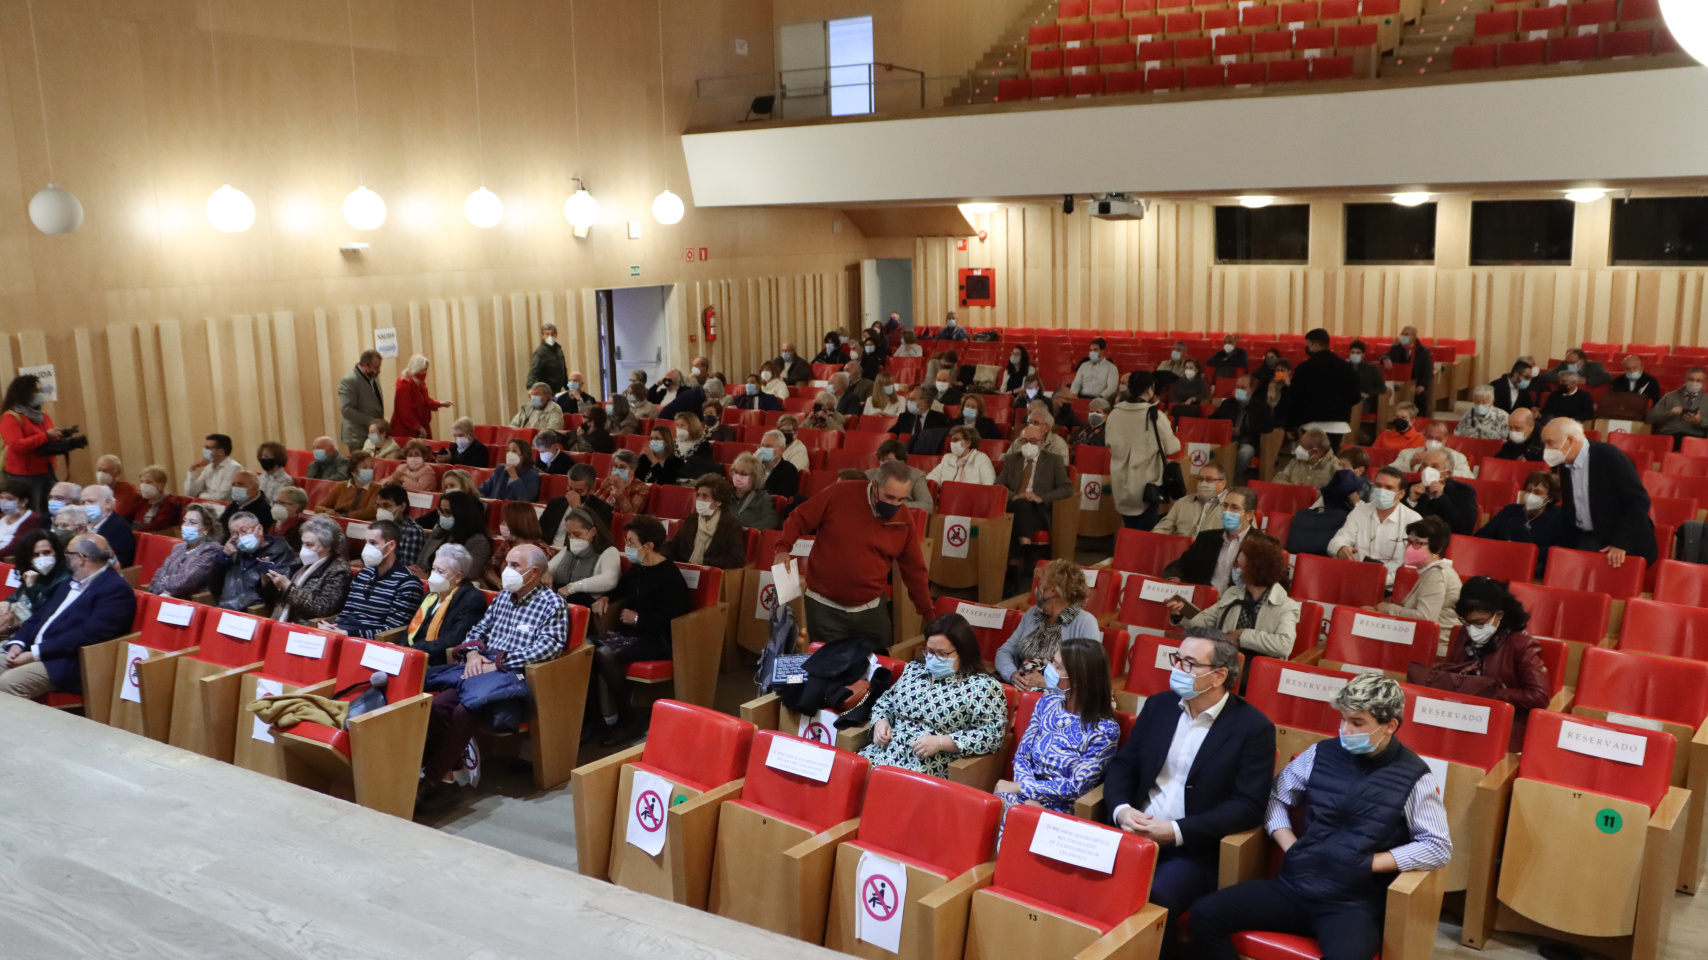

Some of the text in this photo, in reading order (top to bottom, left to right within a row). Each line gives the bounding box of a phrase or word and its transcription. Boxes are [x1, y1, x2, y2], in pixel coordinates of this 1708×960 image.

[1147, 585, 1190, 596] RESERVADO
[960, 607, 1001, 619] RESERVADO
[1359, 619, 1410, 633] RESERVADO
[1421, 706, 1483, 723] RESERVADO
[1567, 731, 1638, 753] RESERVADO
[1572, 792, 1582, 800] 17
[1603, 815, 1615, 828] 11
[1029, 913, 1037, 922] 13
